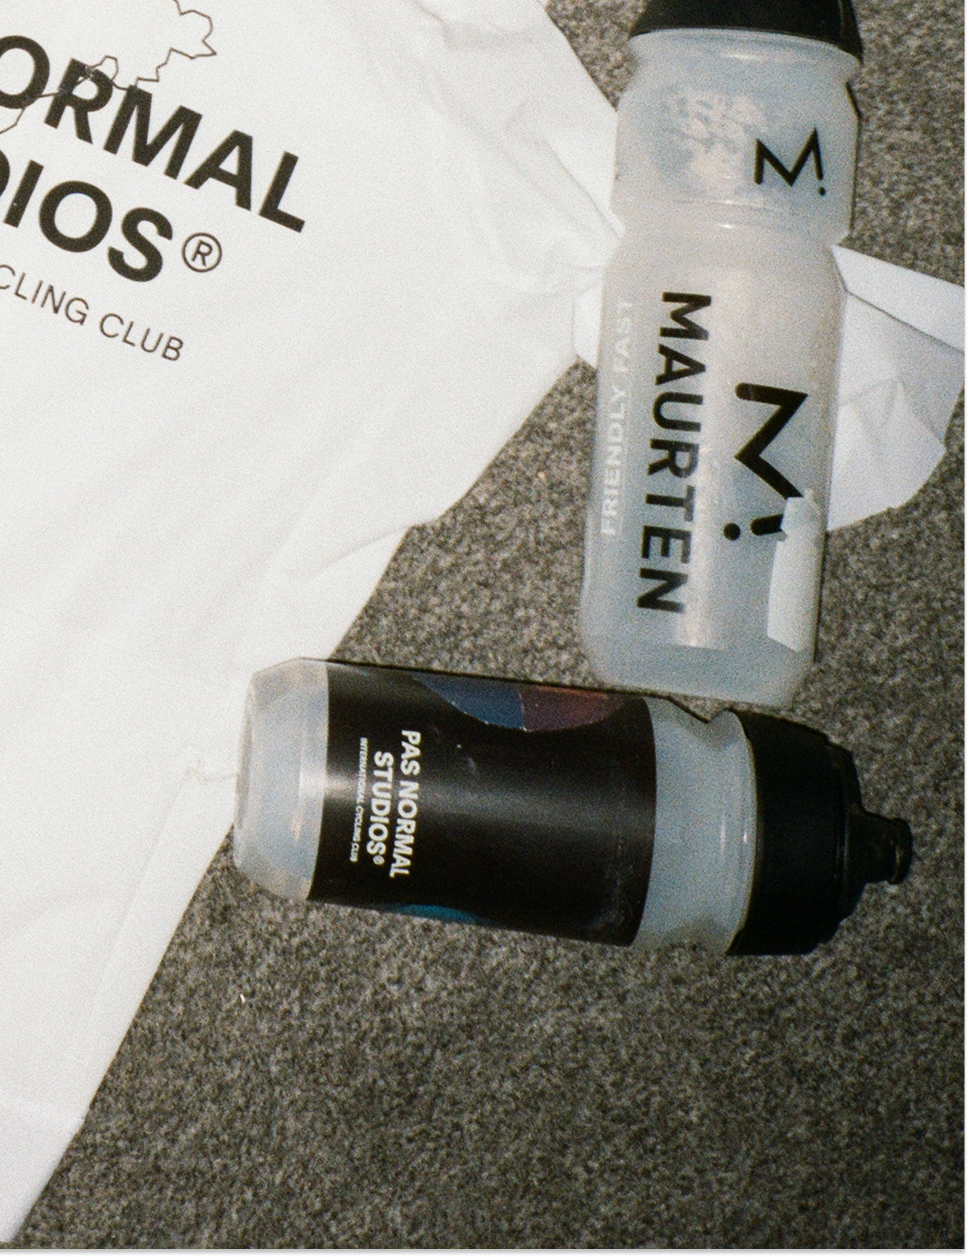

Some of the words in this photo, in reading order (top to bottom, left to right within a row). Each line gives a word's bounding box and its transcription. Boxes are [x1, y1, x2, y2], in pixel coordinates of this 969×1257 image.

[99, 312, 184, 362] CLUB
[612, 300, 632, 373] FAST
[601, 383, 626, 536] FRIENDLY
[636, 292, 712, 613] MAURTEN
[357, 737, 368, 804] INTERNATIONAL
[400, 730, 422, 776] PAS
[353, 805, 364, 842] CYCLING
[389, 780, 420, 878] NORMAL
